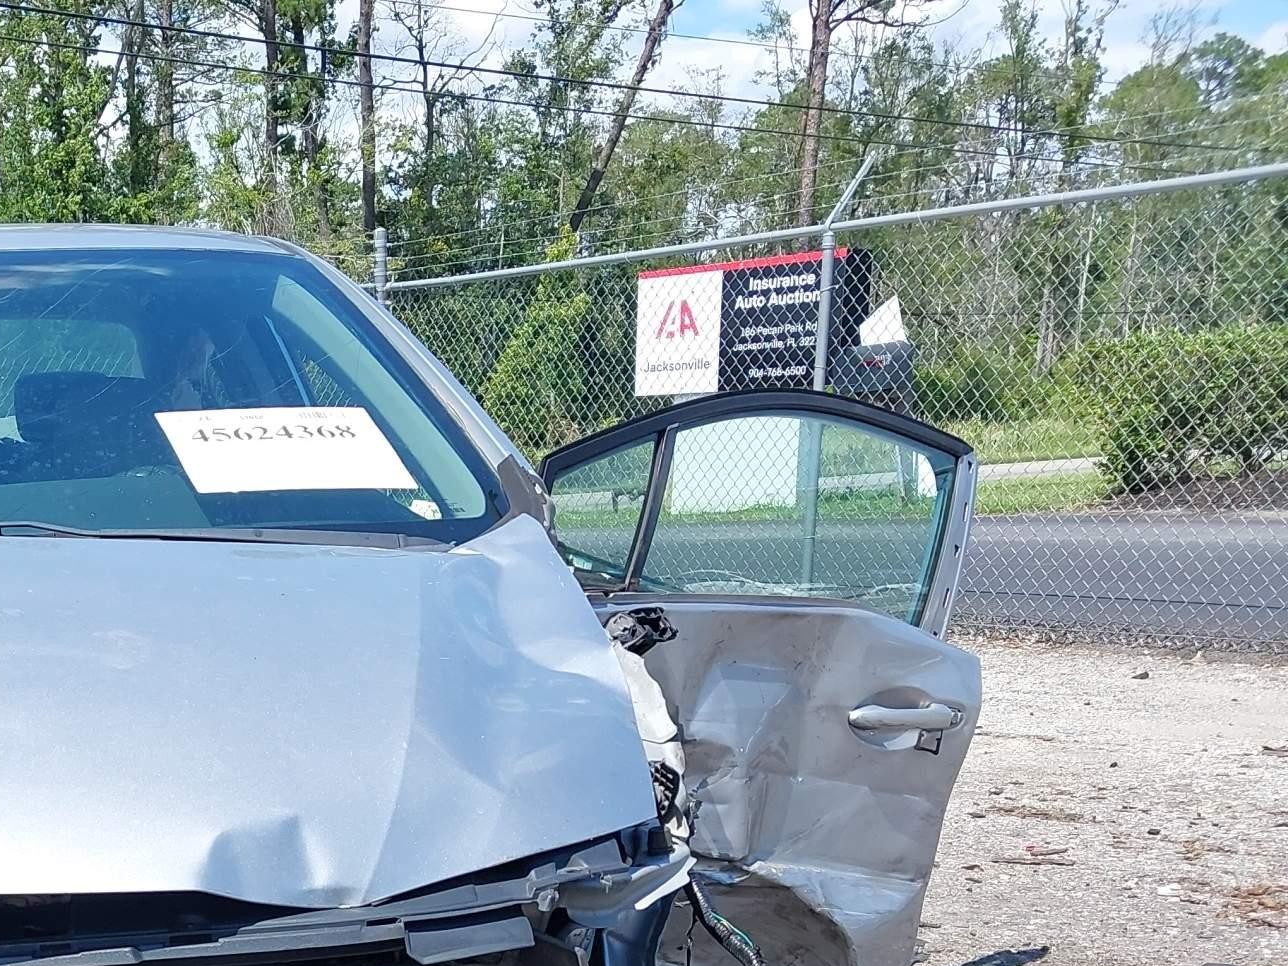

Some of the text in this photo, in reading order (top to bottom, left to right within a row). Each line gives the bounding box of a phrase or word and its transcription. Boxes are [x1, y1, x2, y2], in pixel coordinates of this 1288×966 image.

[749, 273, 816, 291] Insurance
[735, 288, 821, 309] Auto Auction
[757, 325, 783, 336] Pecan
[785, 322, 804, 333] Park
[805, 320, 818, 332] Rd
[787, 337, 798, 348] FL
[799, 335, 816, 347] 322
[643, 358, 711, 373] Jacksonville
[191, 424, 357, 443] 45624368
